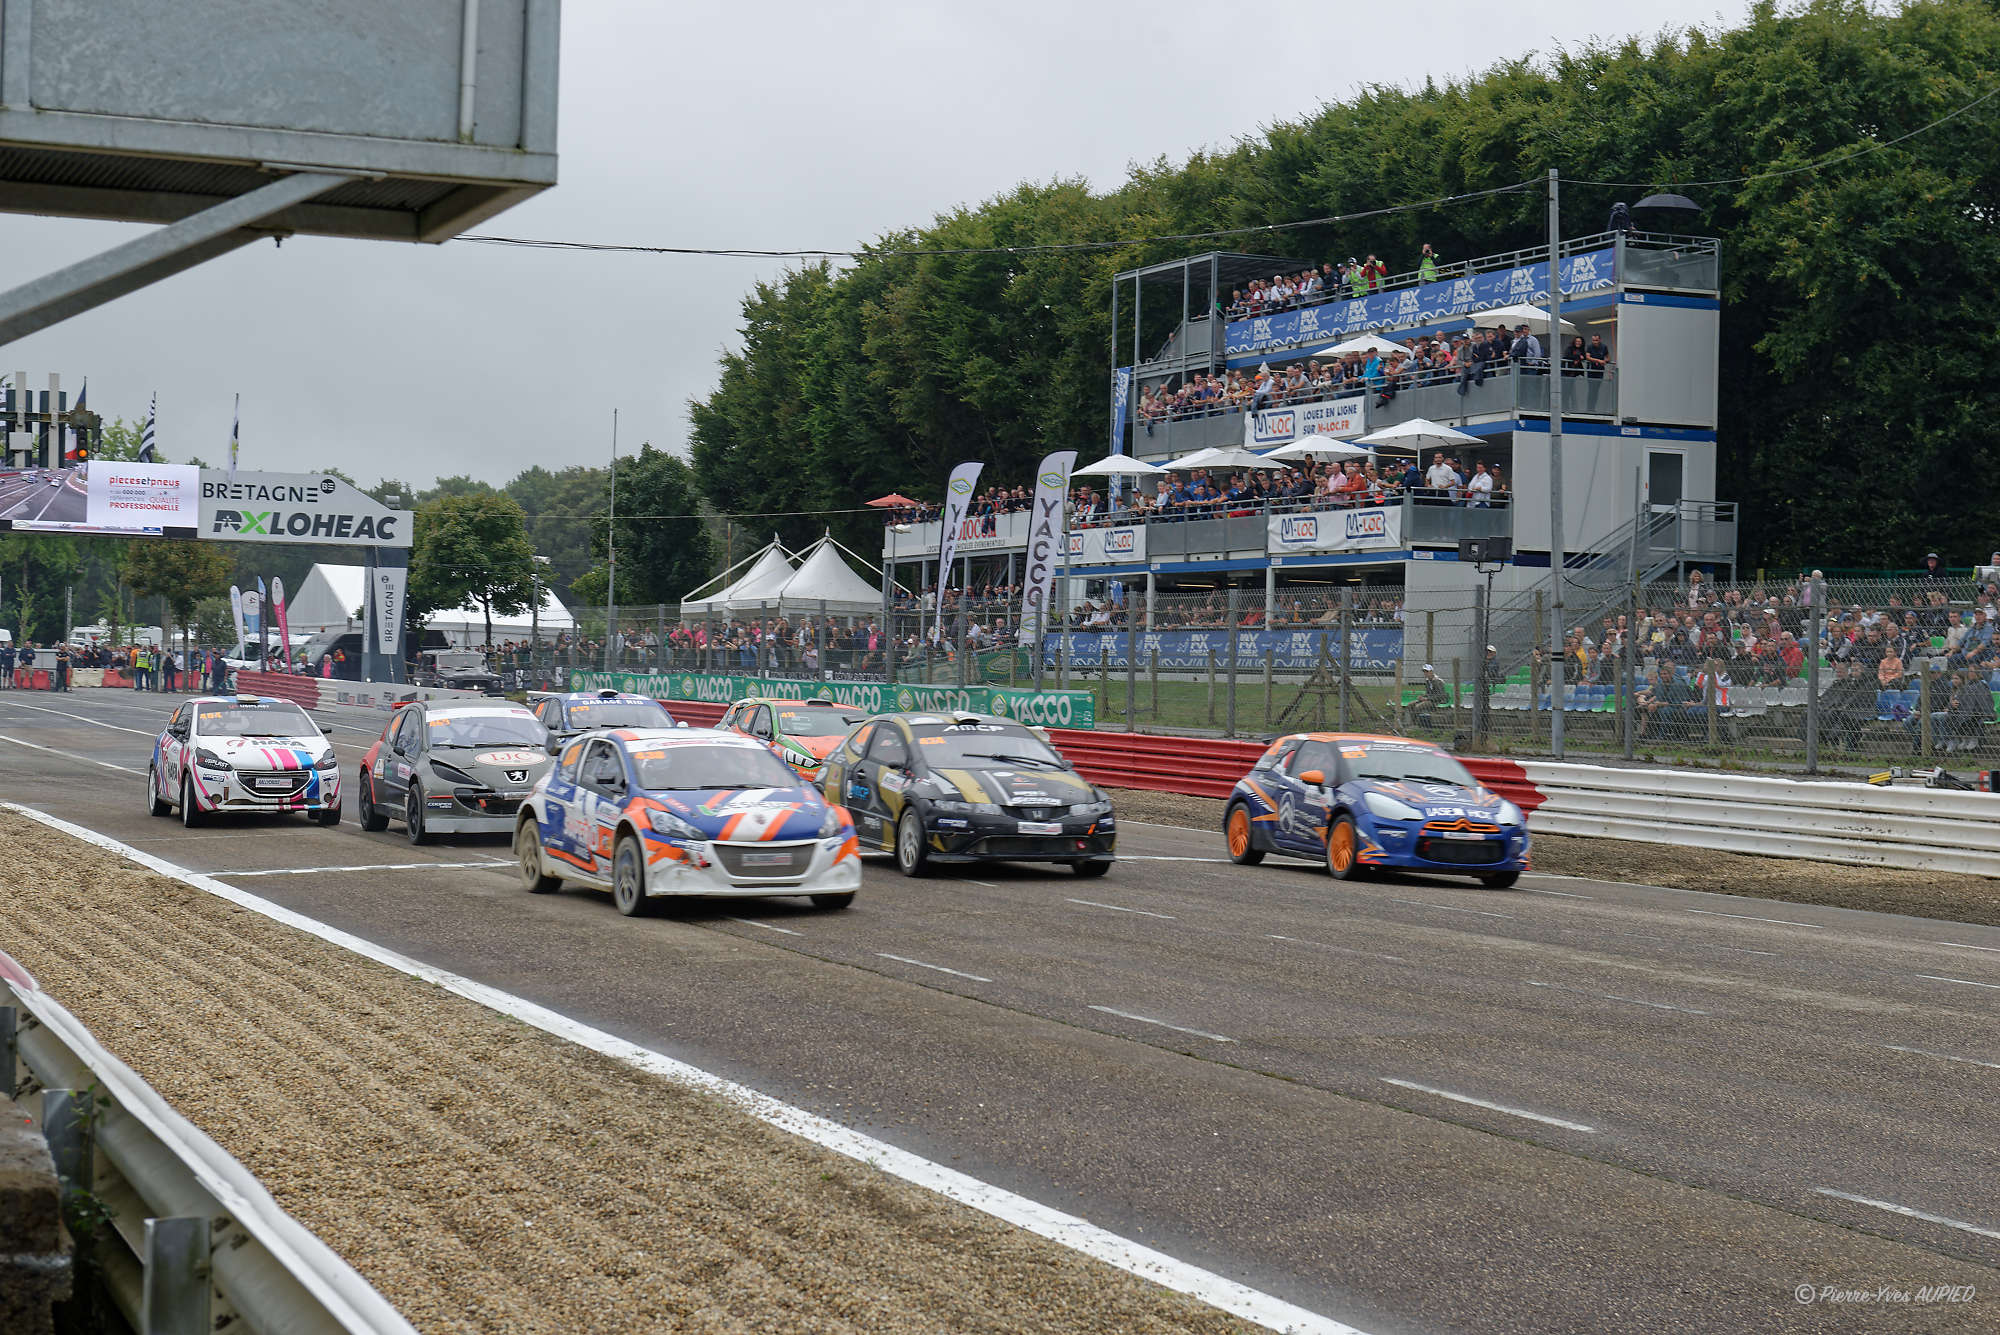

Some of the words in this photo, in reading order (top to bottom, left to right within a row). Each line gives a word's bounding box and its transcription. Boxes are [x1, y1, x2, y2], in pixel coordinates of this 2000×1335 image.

[1303, 409, 1324, 421] LOUEZ
[1326, 407, 1335, 417] EN
[1337, 404, 1357, 416] LIGNE
[1303, 424, 1315, 435] SUR
[202, 482, 318, 503] BRETAGNE
[109, 502, 180, 512] PROFESSIONNELLE
[384, 584, 394, 642] BRETAGNE
[637, 676, 670, 698] YACCO
[695, 676, 733, 701] YACCO
[761, 683, 801, 700] YACCO
[835, 685, 881, 713] YACCO
[914, 690, 970, 713] YACCO
[1010, 695, 1072, 725] YACCO
